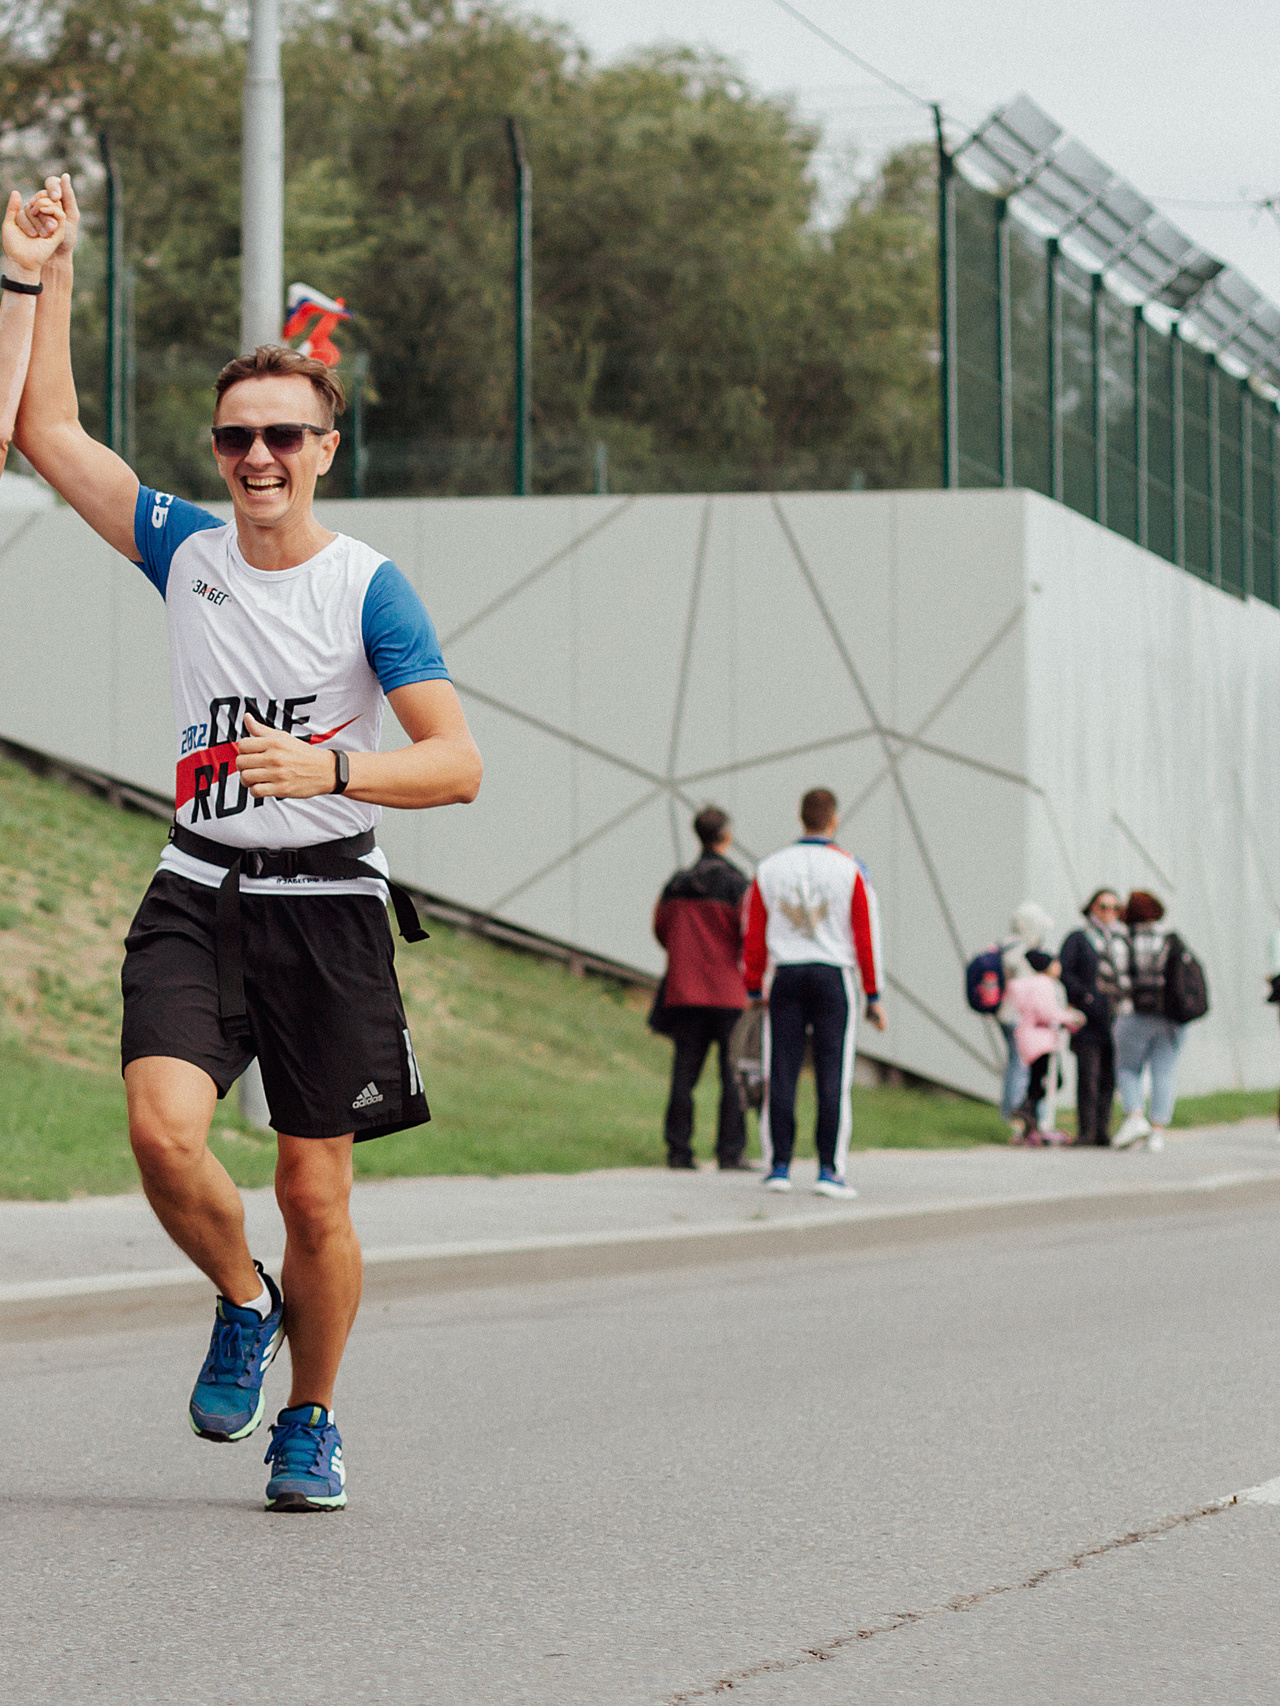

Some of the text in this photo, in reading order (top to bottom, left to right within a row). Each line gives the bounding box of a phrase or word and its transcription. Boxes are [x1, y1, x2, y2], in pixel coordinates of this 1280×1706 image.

[208, 694, 318, 749] ONE
[191, 761, 287, 825] RU
[352, 1093, 384, 1109] adidas
